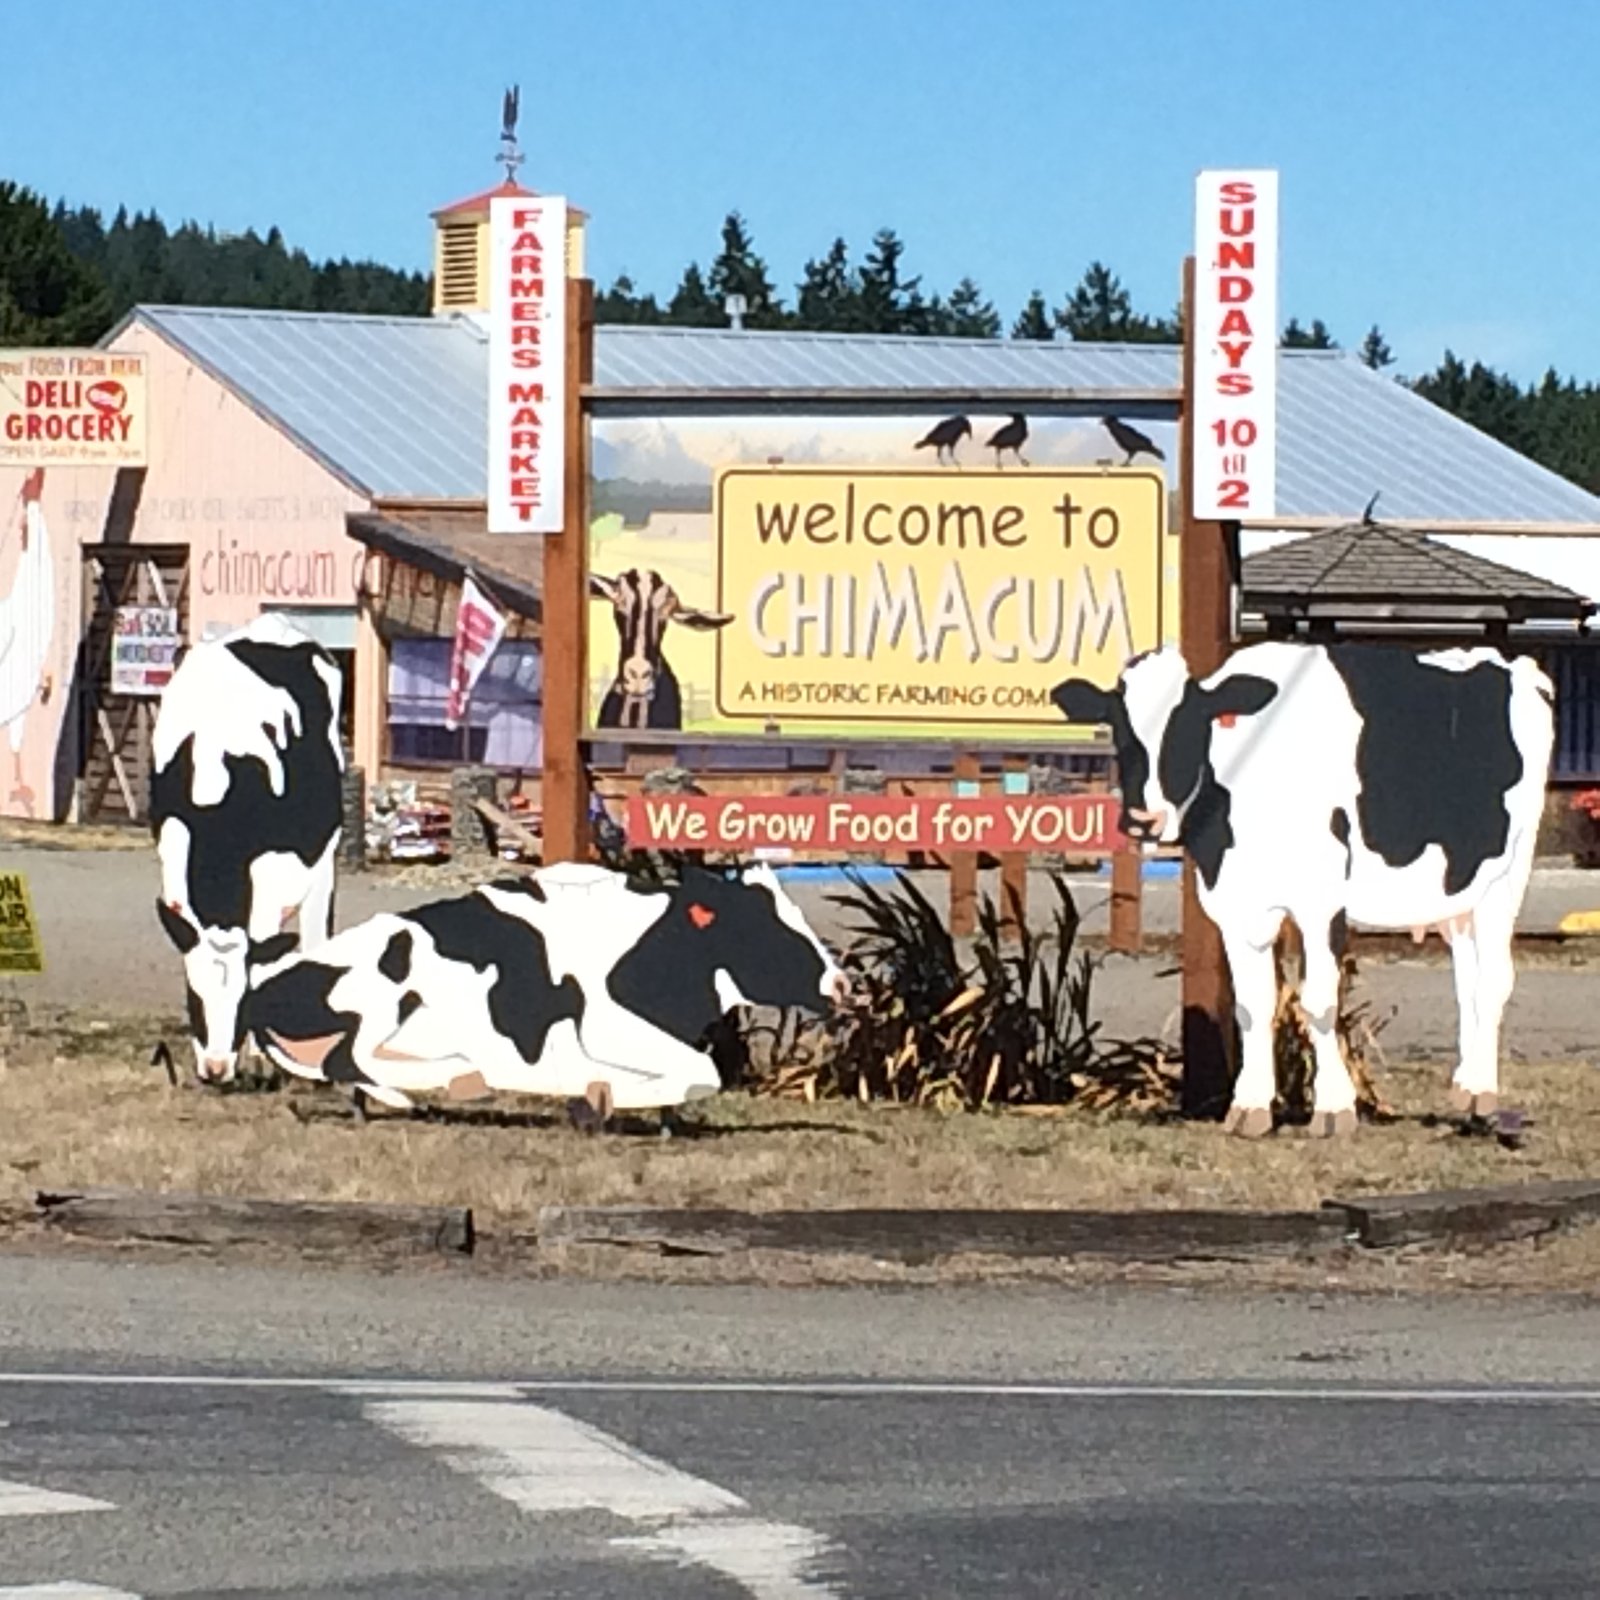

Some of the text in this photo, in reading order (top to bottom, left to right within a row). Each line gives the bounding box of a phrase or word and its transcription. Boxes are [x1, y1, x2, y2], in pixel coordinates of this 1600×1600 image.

[1216, 182, 1256, 396] SUNDAYS
[509, 209, 544, 522] FARMERS MARKET
[25, 380, 82, 408] DELI
[5, 413, 134, 442] GROCERY
[1211, 418, 1257, 448] 10
[1222, 454, 1247, 475] til
[1216, 479, 1250, 509] 2
[755, 483, 1120, 549] welcome to
[199, 529, 337, 599] chimacum
[749, 559, 1136, 667] CHIMACUM
[738, 681, 1052, 708] A HISTORIC FARMING COM
[645, 802, 1106, 845] We Grow Food for YOU!
